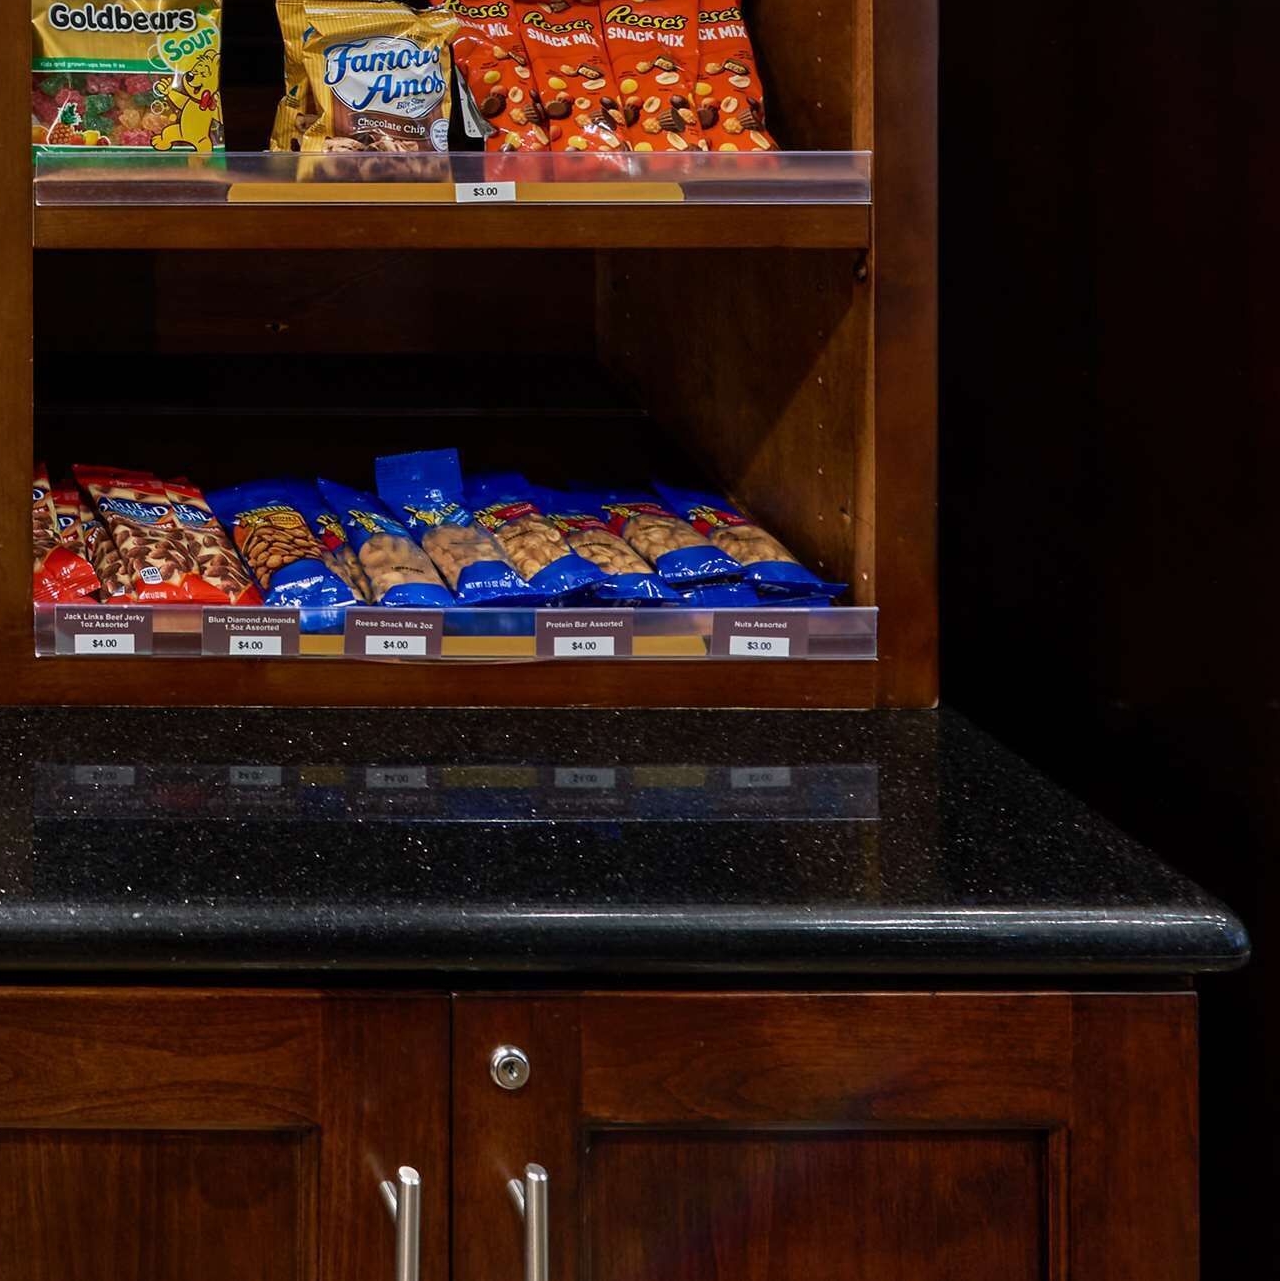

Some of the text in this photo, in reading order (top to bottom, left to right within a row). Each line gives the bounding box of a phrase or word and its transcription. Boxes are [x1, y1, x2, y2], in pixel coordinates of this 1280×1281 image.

[51, 4, 197, 32] Goldbears
[606, 6, 688, 31] Reese's
[163, 27, 215, 63] Sour
[607, 27, 685, 48] SNACK MIX
[323, 41, 443, 86] Famous
[352, 74, 446, 111] Amos
[358, 118, 425, 134] Chocolate Chip
[473, 187, 497, 197] $3.00
[546, 621, 572, 629] Protein
[590, 620, 623, 628] Assorted
[572, 641, 596, 651] $4.00
